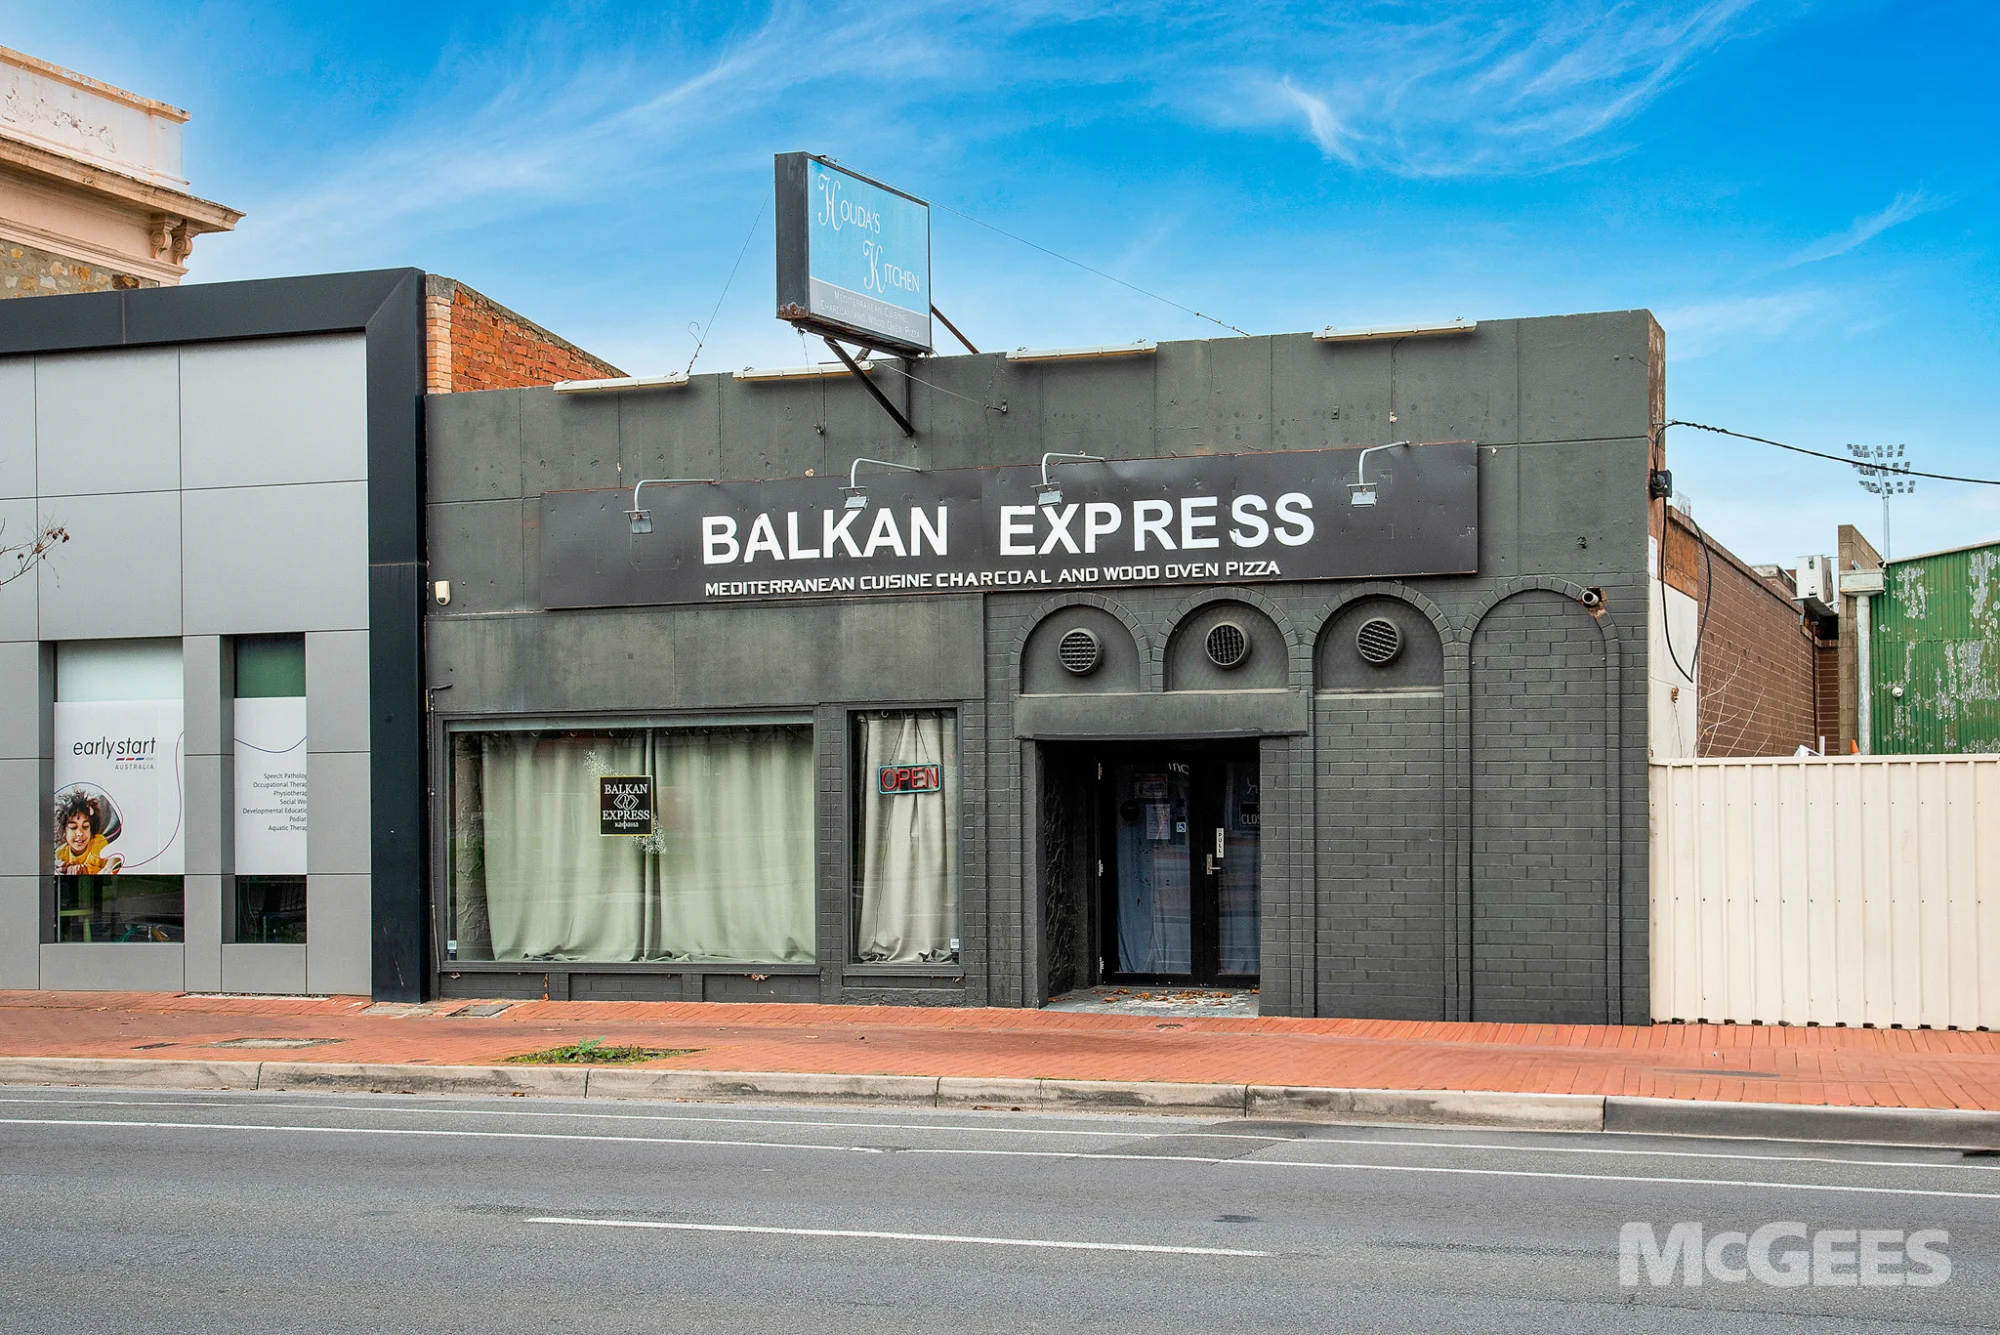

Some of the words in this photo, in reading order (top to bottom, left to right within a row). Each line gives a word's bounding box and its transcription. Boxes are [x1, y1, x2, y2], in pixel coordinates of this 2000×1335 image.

[702, 505, 948, 565] BALKAN
[999, 492, 1315, 556] EXPRESS
[705, 576, 855, 596] MEDITERRANEAN
[860, 573, 932, 591] CUISINE
[936, 569, 1051, 587] CHARCOAL
[1058, 567, 1099, 583] AND
[1103, 565, 1160, 581] WOOD
[1165, 562, 1219, 579] OVEN
[1226, 560, 1281, 577] PIZZA
[115, 763, 154, 771] AUSTRALIA
[264, 772, 283, 780] Speech
[284, 772, 307, 780] Patholog
[881, 766, 939, 791] OPEN
[253, 781, 289, 789] Occupational
[604, 783, 648, 795] BALKAN
[242, 807, 283, 815] Developmental
[602, 810, 650, 820] EXPRESS
[268, 824, 289, 832] Aquatic
